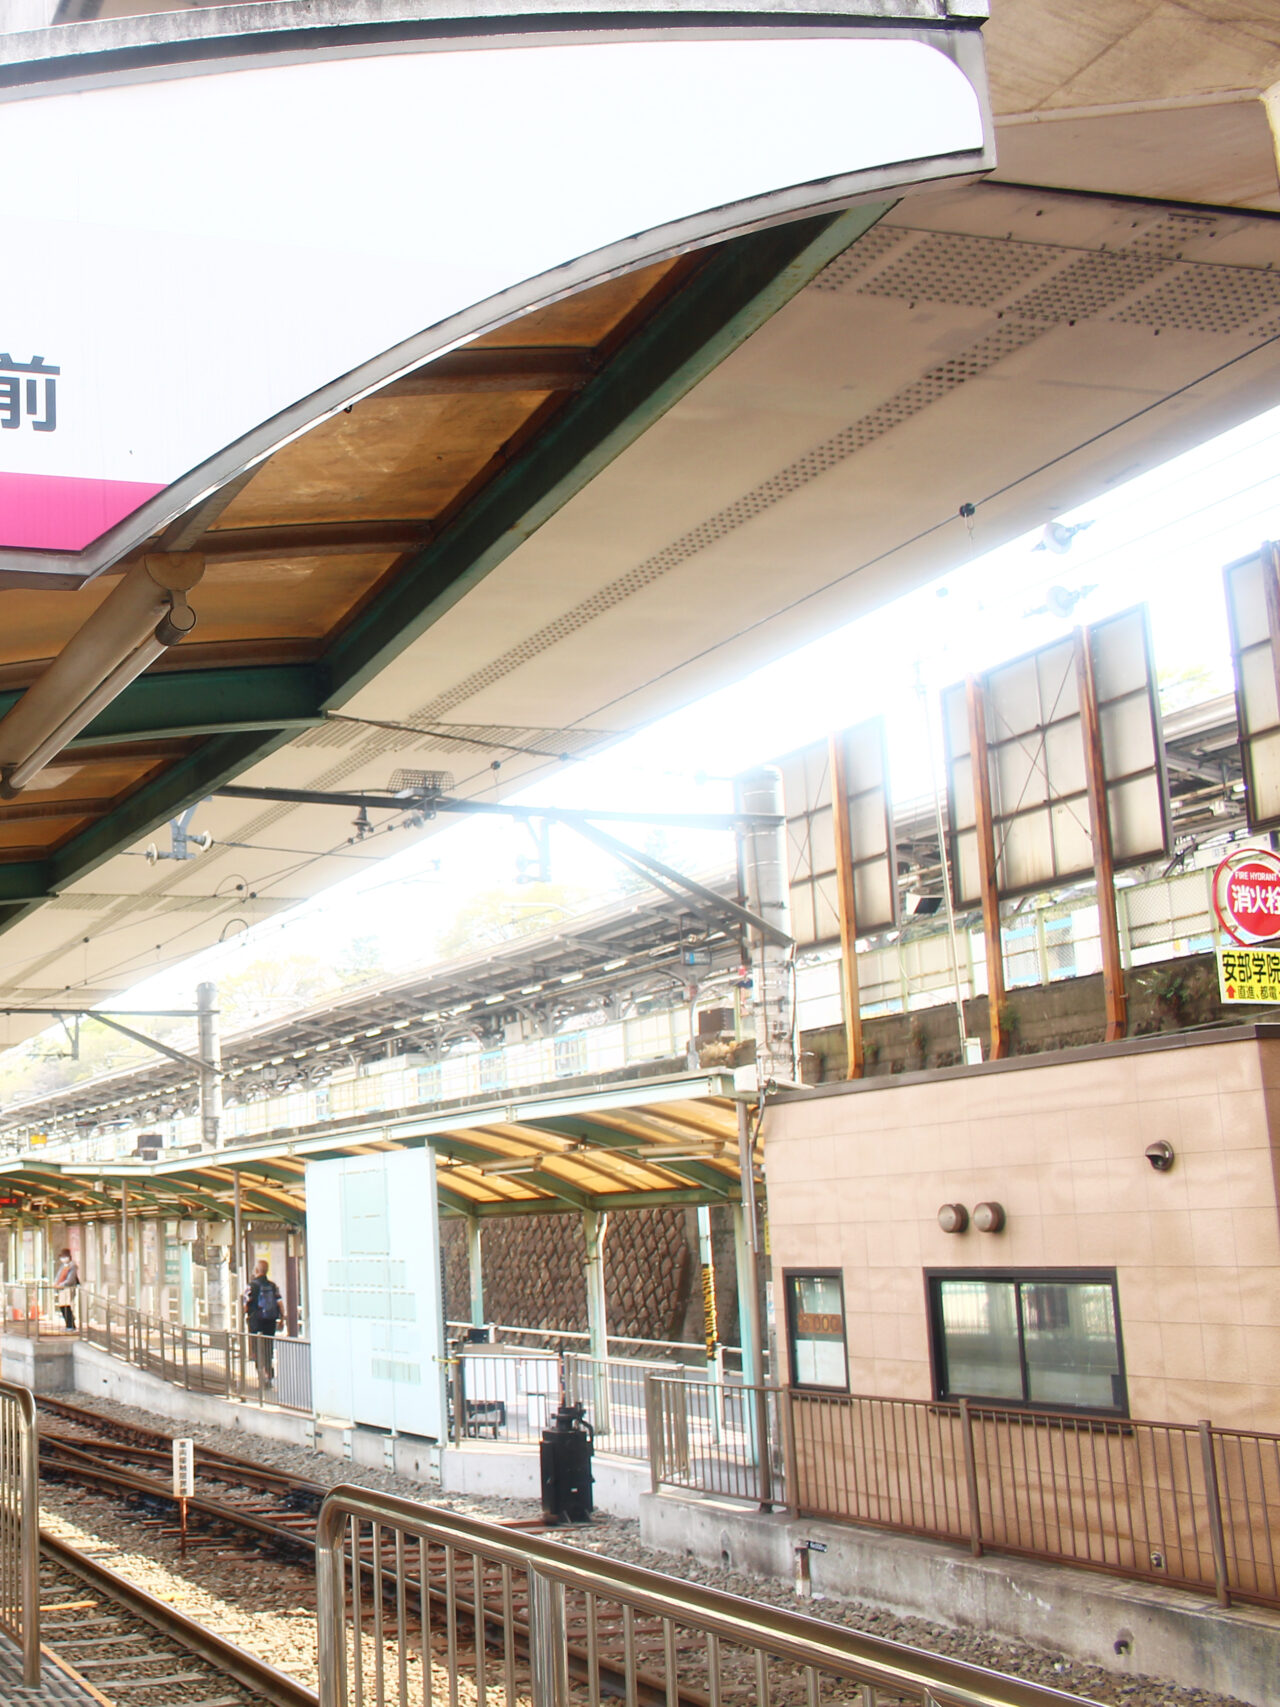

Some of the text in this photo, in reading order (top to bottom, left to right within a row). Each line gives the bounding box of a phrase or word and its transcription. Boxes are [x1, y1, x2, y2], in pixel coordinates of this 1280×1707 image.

[1234, 871, 1277, 882] FIRE HYDRANT
[1222, 952, 1280, 984] 安部学院
